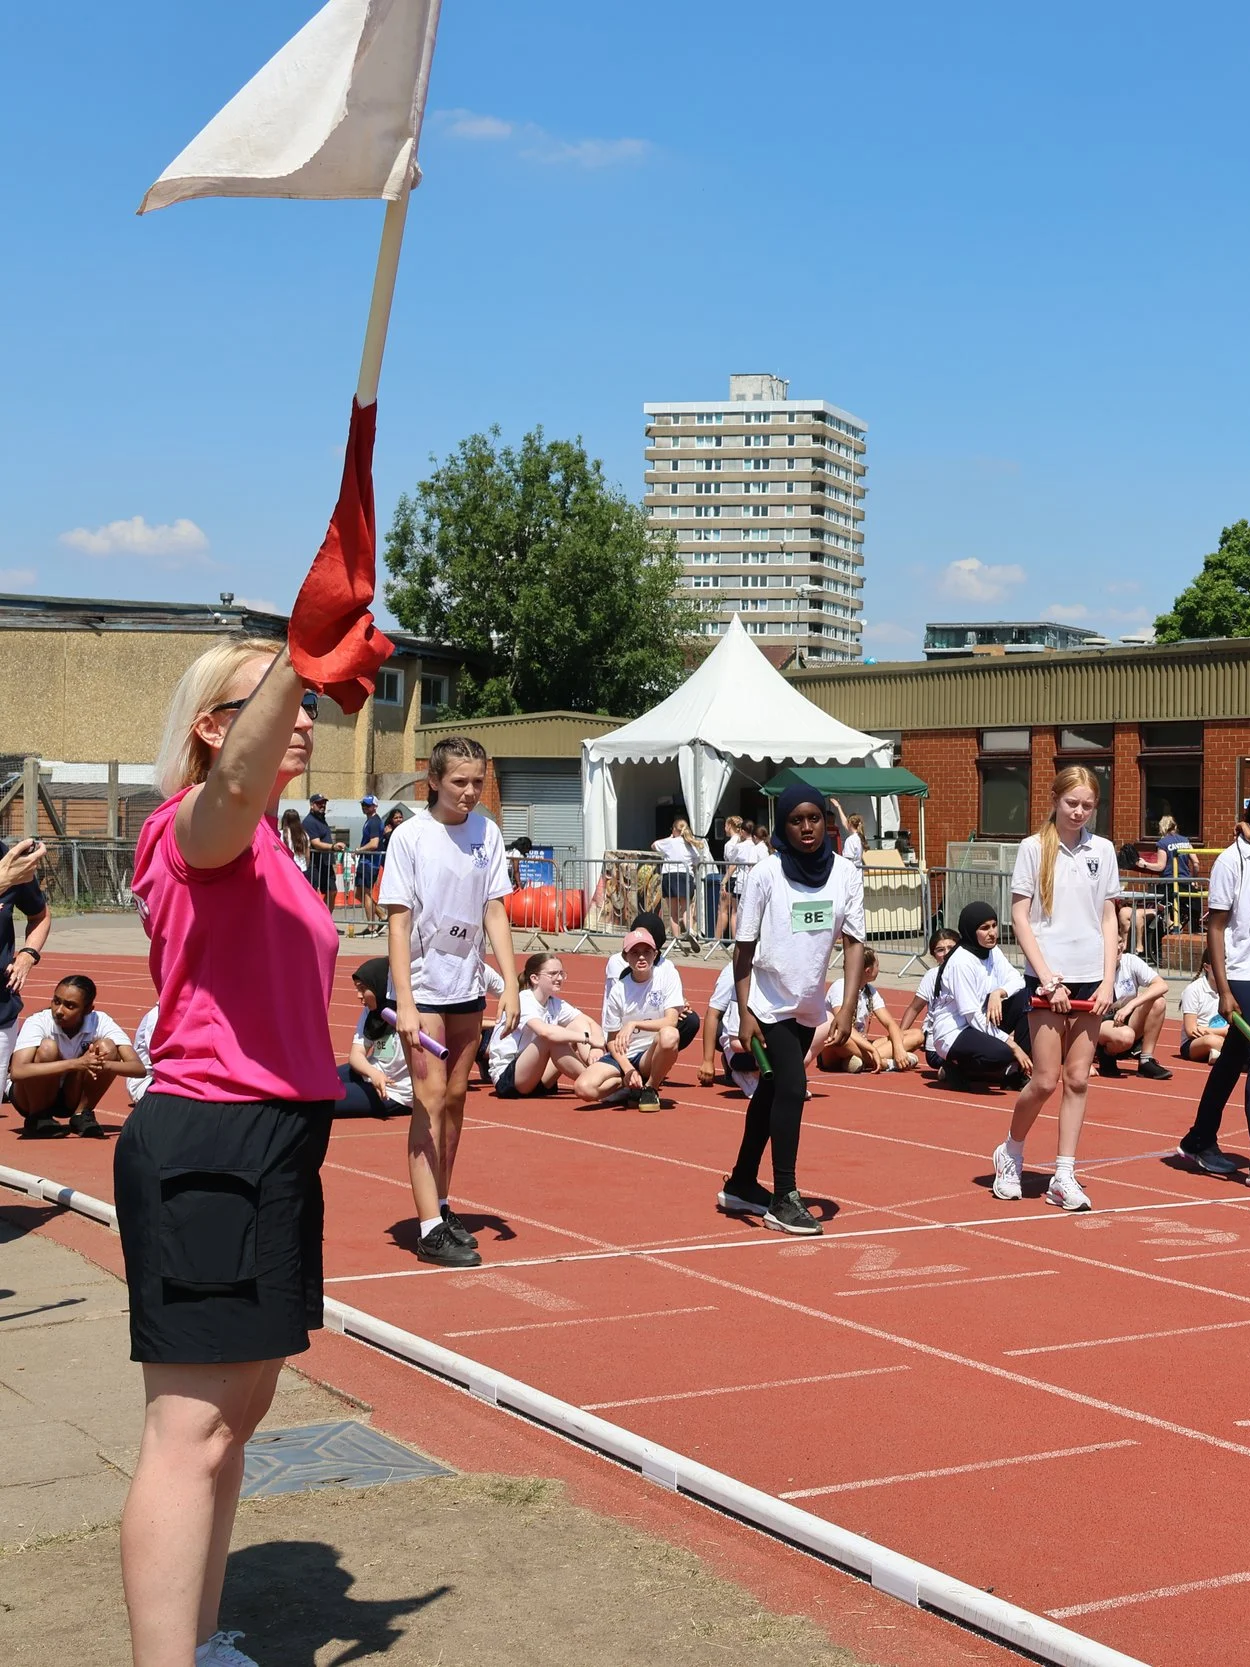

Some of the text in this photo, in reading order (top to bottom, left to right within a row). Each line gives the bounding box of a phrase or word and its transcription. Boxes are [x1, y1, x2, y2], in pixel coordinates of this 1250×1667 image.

[804, 911, 824, 924] 8E
[449, 925, 467, 940] 8A
[777, 1241, 970, 1281] 2
